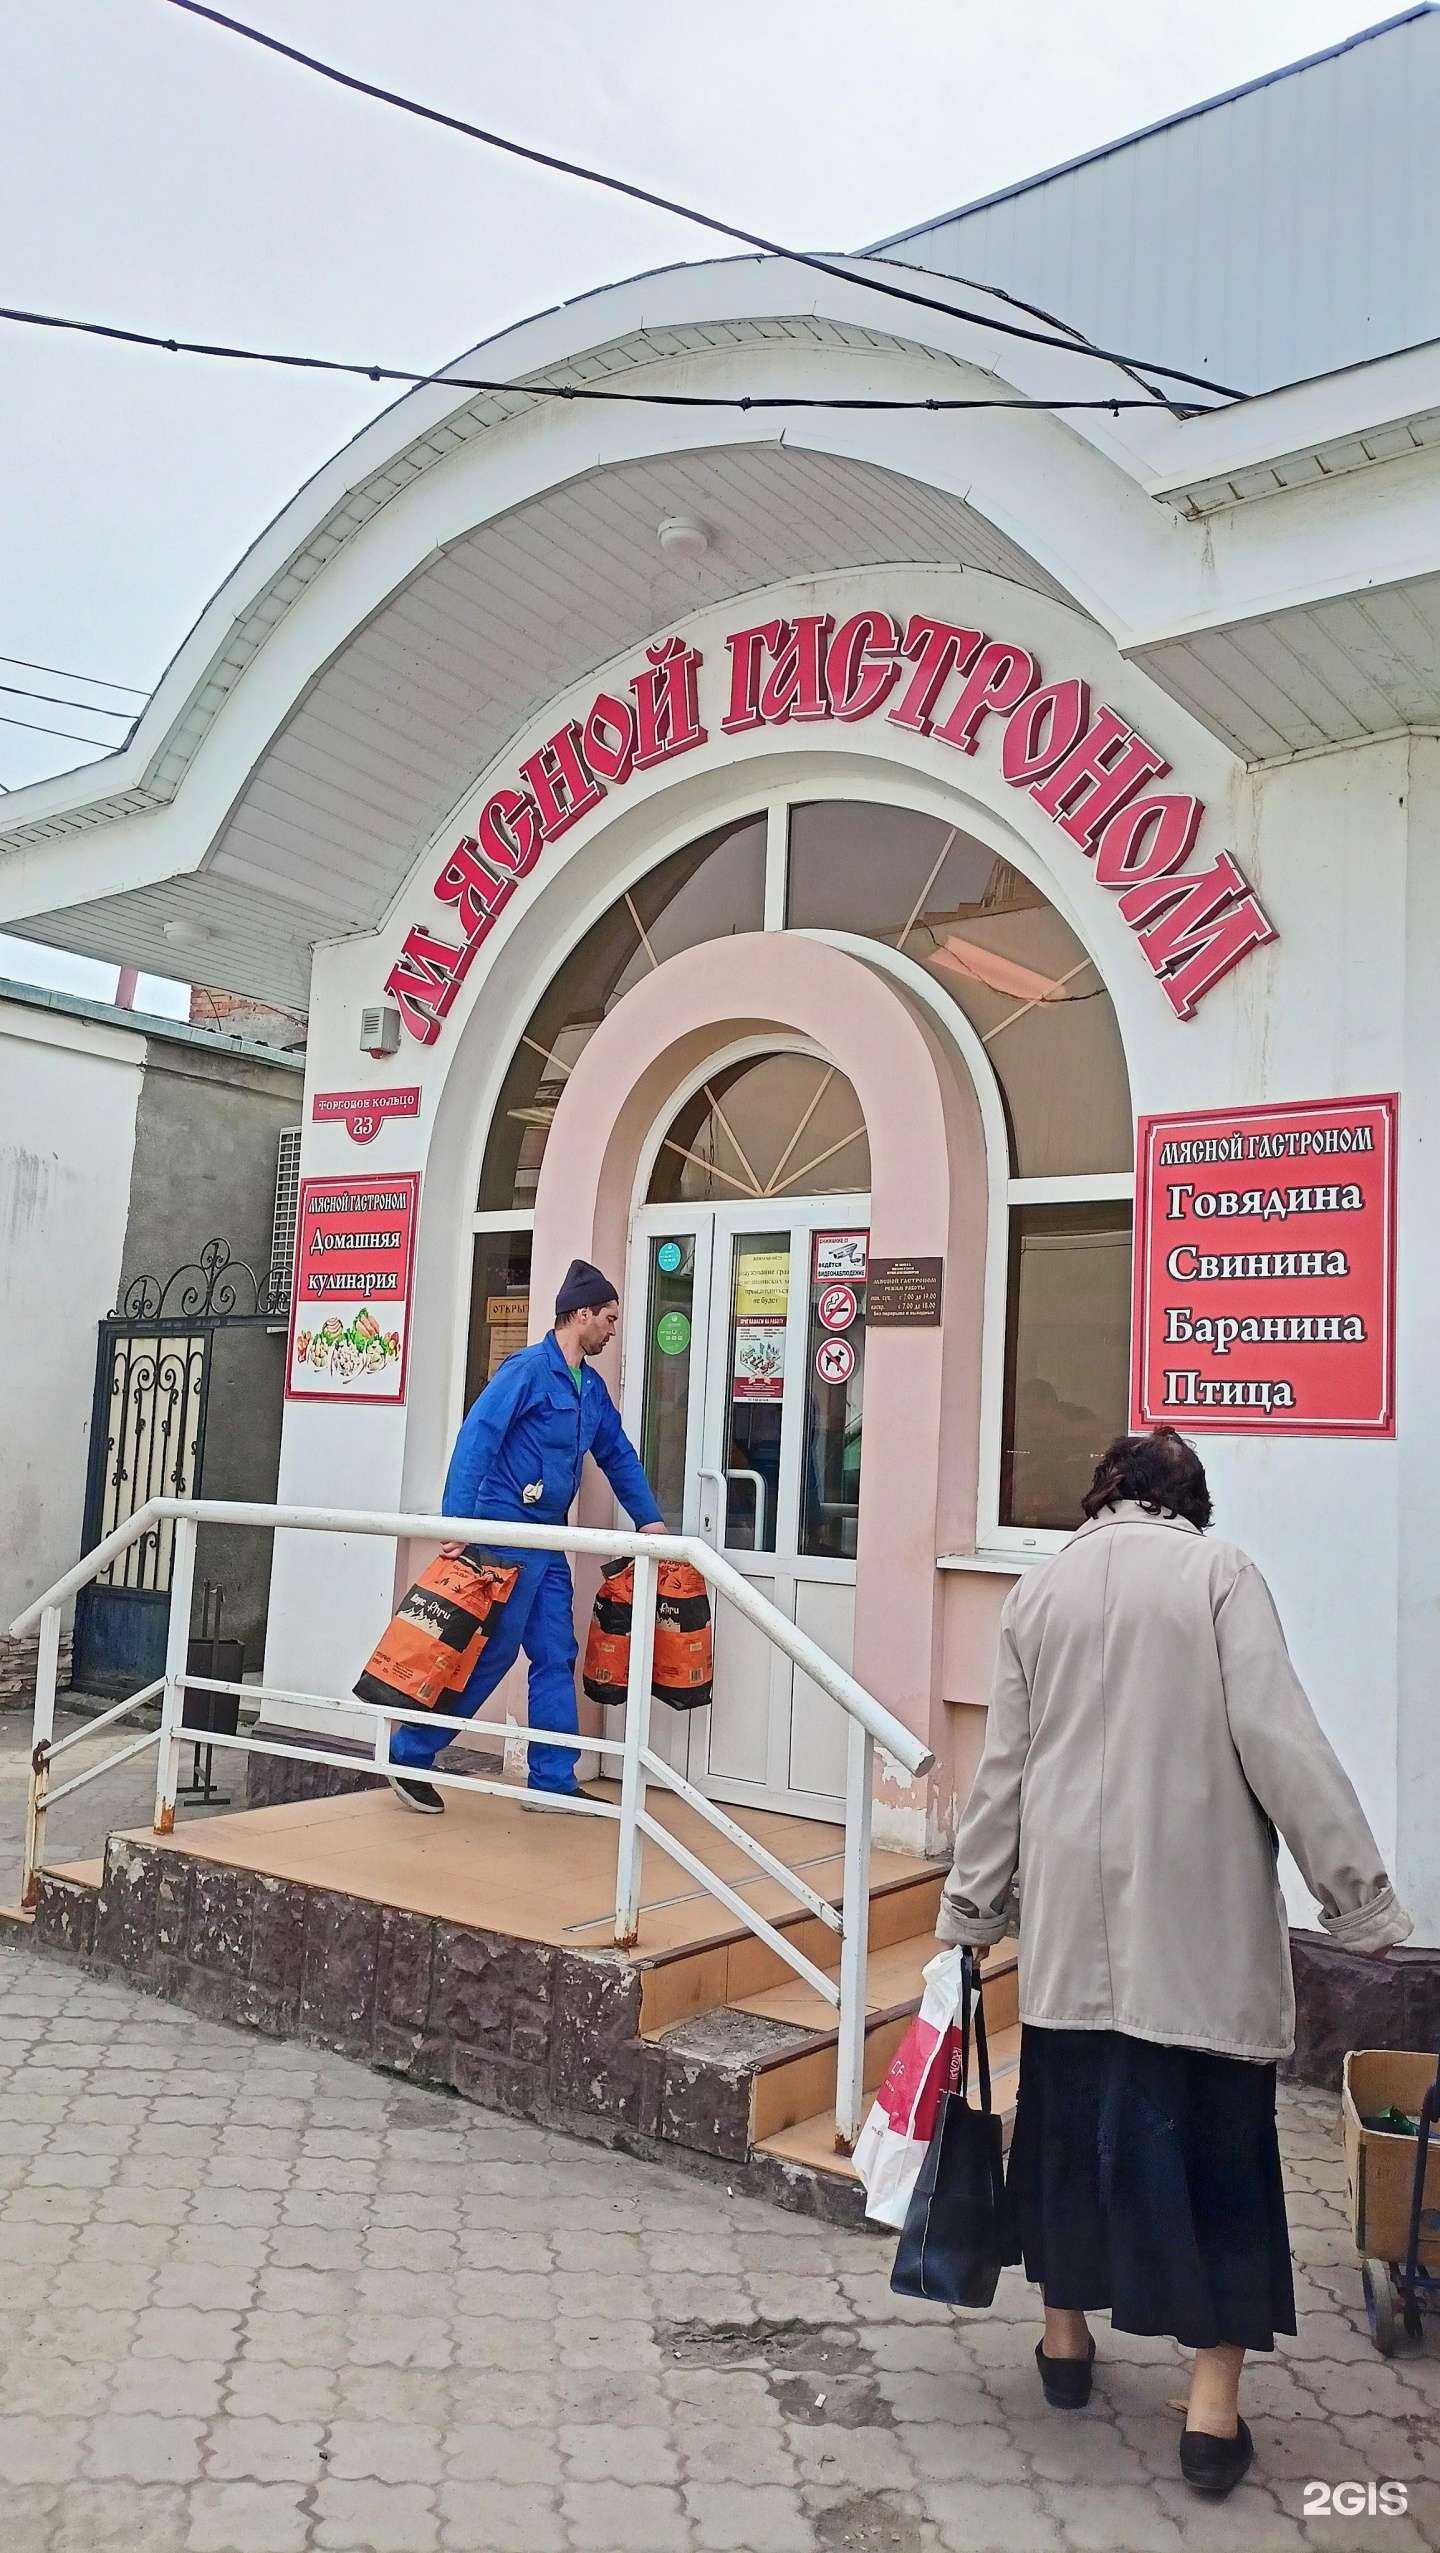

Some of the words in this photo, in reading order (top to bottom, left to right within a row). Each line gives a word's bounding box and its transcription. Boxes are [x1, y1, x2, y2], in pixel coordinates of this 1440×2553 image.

[382, 636, 708, 1047] МЯСНОЙ
[720, 608, 1281, 1024] ГАСТРОНОМ
[318, 1098, 370, 1111] ТОРГОВОЕ
[372, 1095, 415, 1109] КОЛЬЦО
[352, 1116, 374, 1135] 23
[1160, 1131, 1244, 1165] МЯСНОЙ
[1247, 1126, 1375, 1160] ГАСТРОНОМ
[308, 1191, 349, 1213] МЯСНОЙ
[348, 1192, 407, 1212] ГАСТРОНОМ
[1167, 1183, 1366, 1221] Говядина
[310, 1227, 401, 1256] Домашняя
[1167, 1245, 1350, 1281] Свинина
[307, 1272, 398, 1297] кулинария
[1164, 1307, 1368, 1355] Баранина
[1163, 1370, 1296, 1414] Птица
